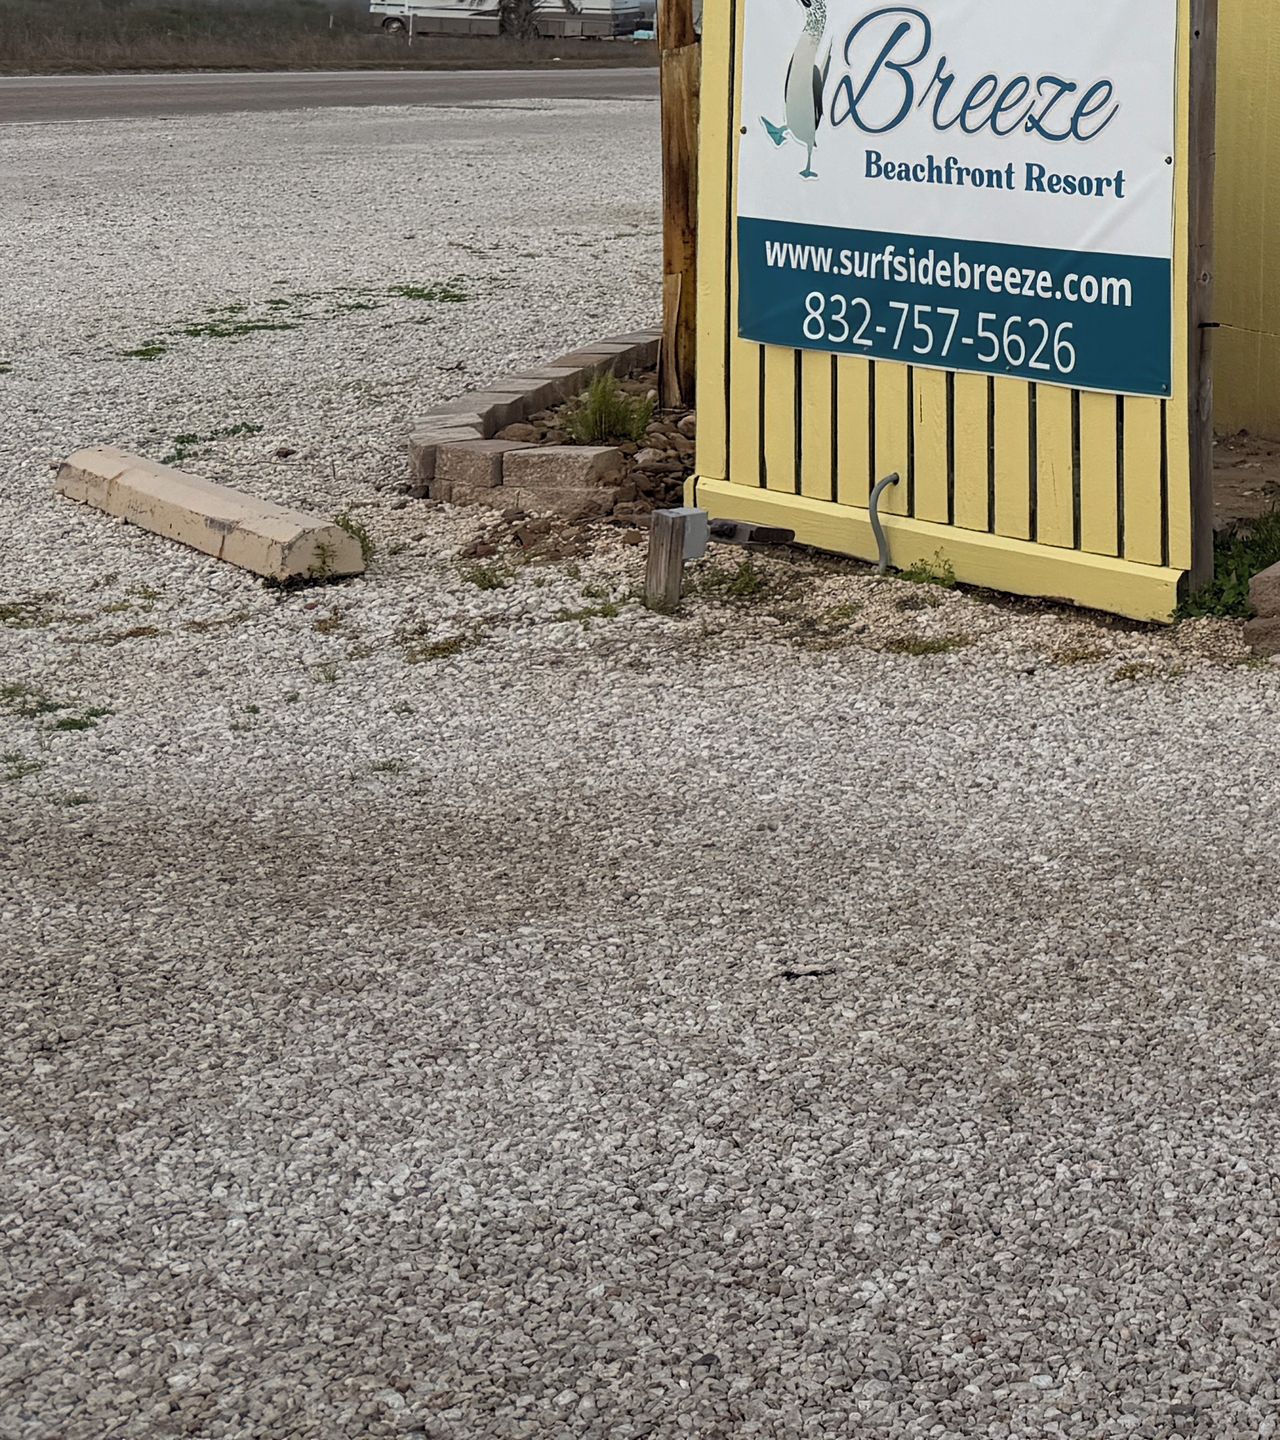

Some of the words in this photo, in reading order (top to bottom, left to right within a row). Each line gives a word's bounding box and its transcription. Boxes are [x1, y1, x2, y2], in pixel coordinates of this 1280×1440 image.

[830, 6, 1120, 142] Breeze
[864, 150, 1016, 191] Beachfront
[1024, 162, 1126, 199] Resort
[765, 240, 1133, 307] www.surfsidebreeze.com
[802, 291, 1077, 373] 832-757-5626
